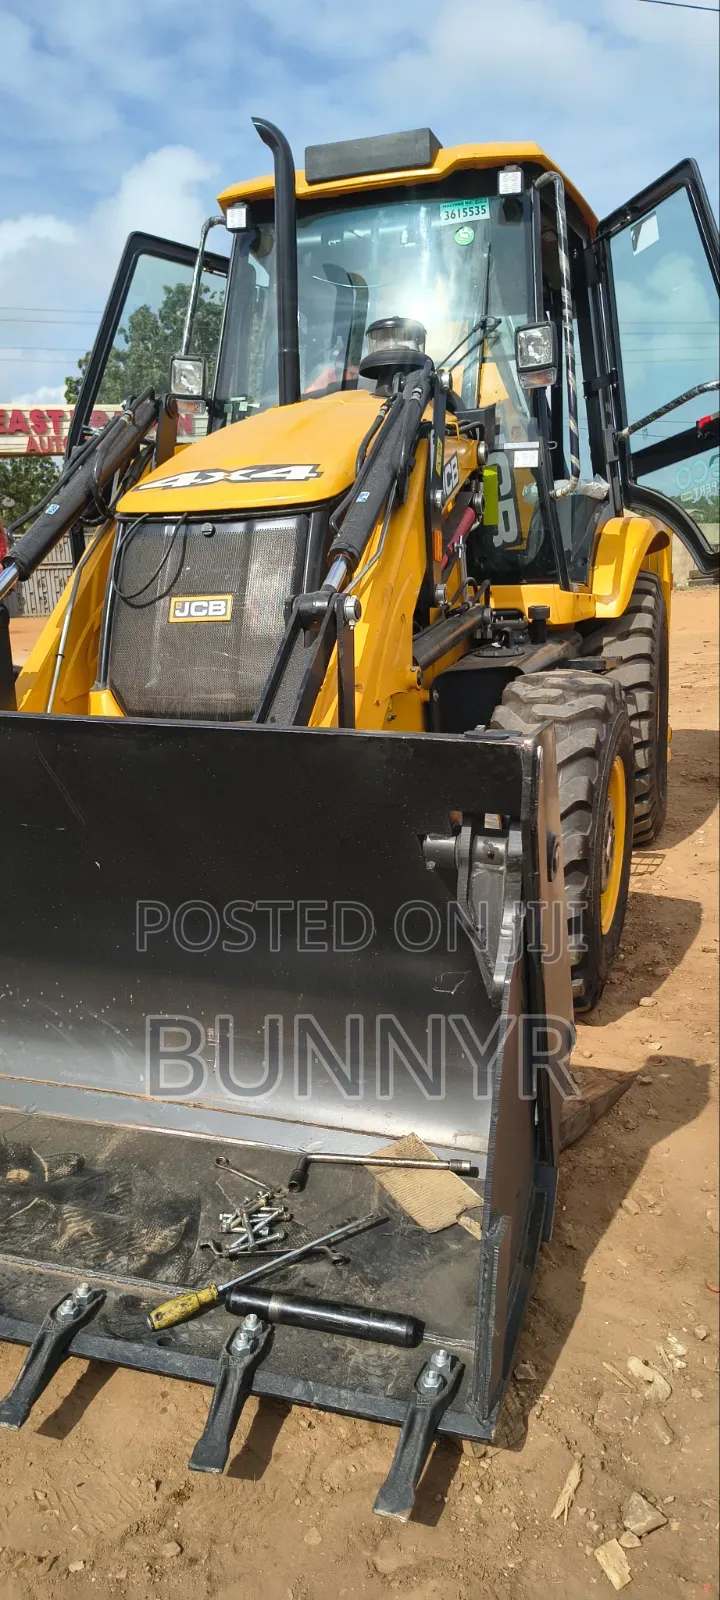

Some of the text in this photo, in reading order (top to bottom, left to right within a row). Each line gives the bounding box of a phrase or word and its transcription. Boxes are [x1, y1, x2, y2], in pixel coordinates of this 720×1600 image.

[444, 205, 487, 221] 3615535
[443, 454, 459, 496] CB
[174, 600, 227, 617] JCB
